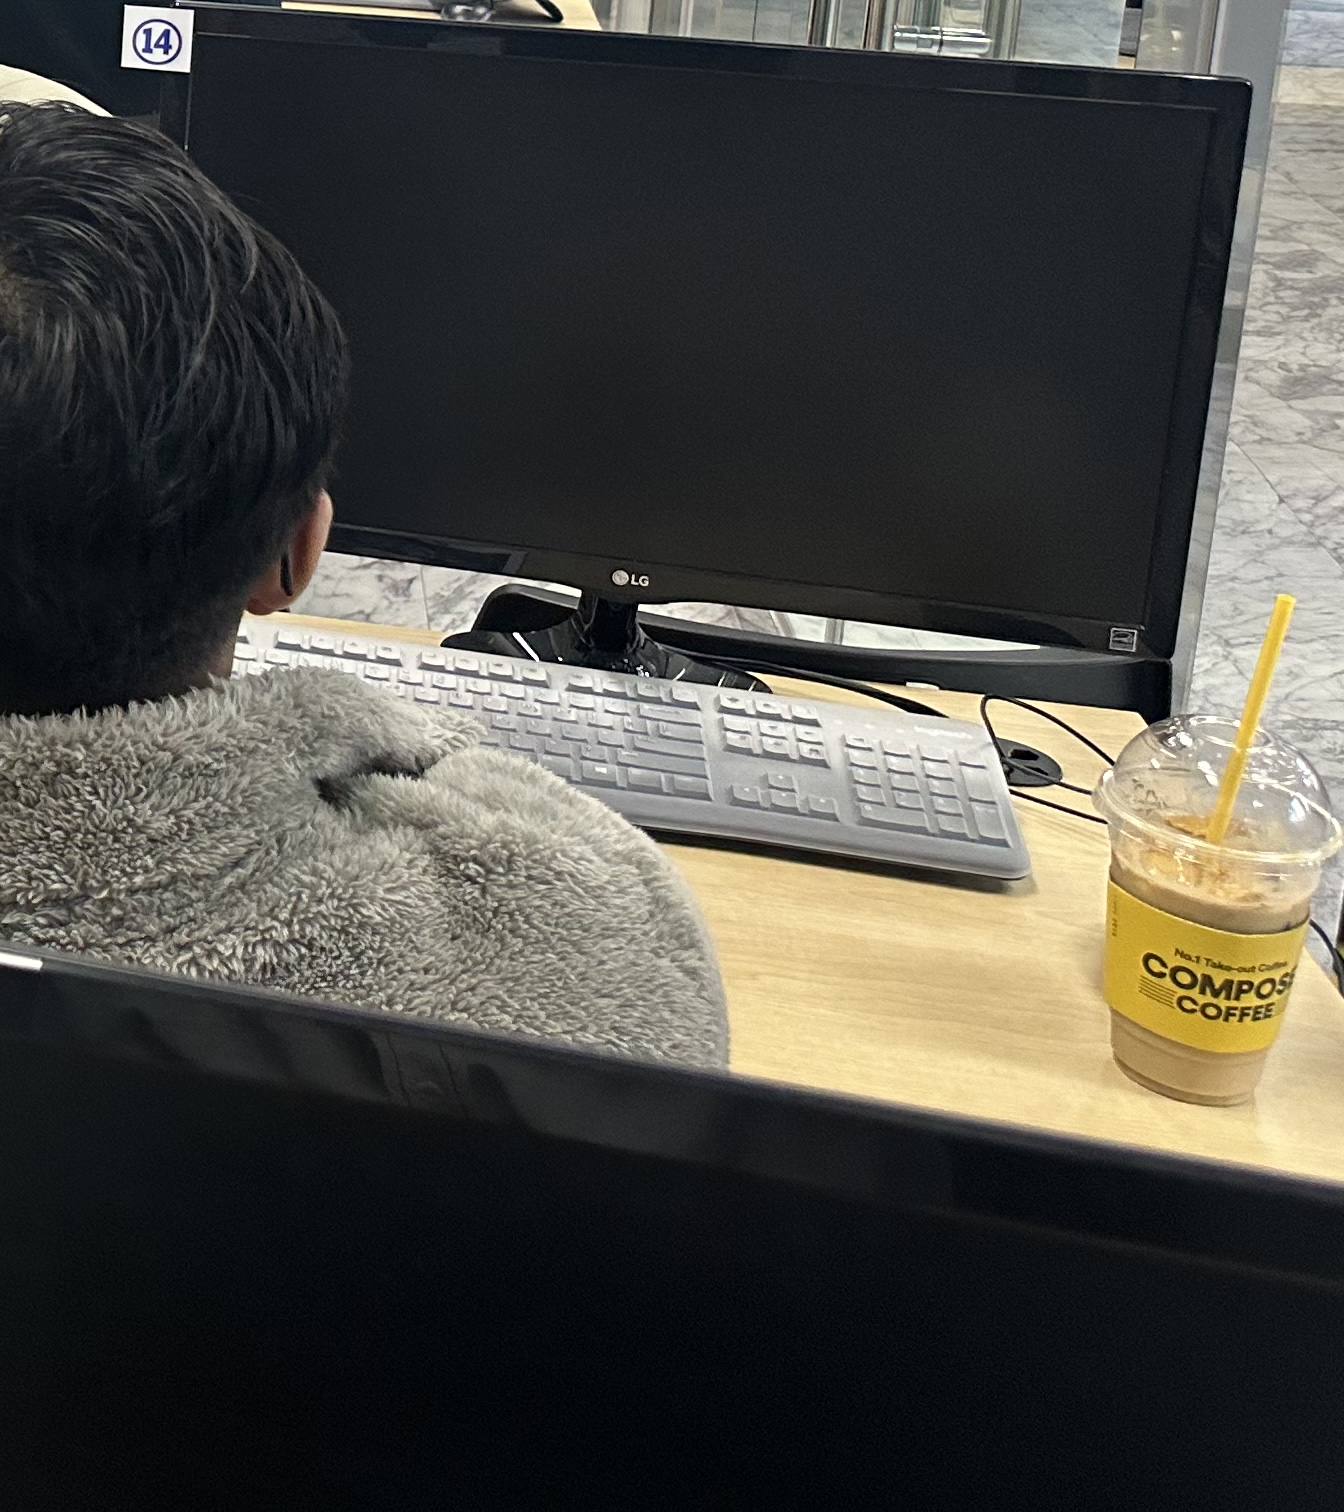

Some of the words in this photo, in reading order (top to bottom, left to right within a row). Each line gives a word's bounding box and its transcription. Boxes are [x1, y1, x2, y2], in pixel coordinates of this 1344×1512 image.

[1173, 947, 1201, 965] No.1
[1203, 957, 1257, 974] Take-out
[1175, 994, 1277, 1024] COFFEE
